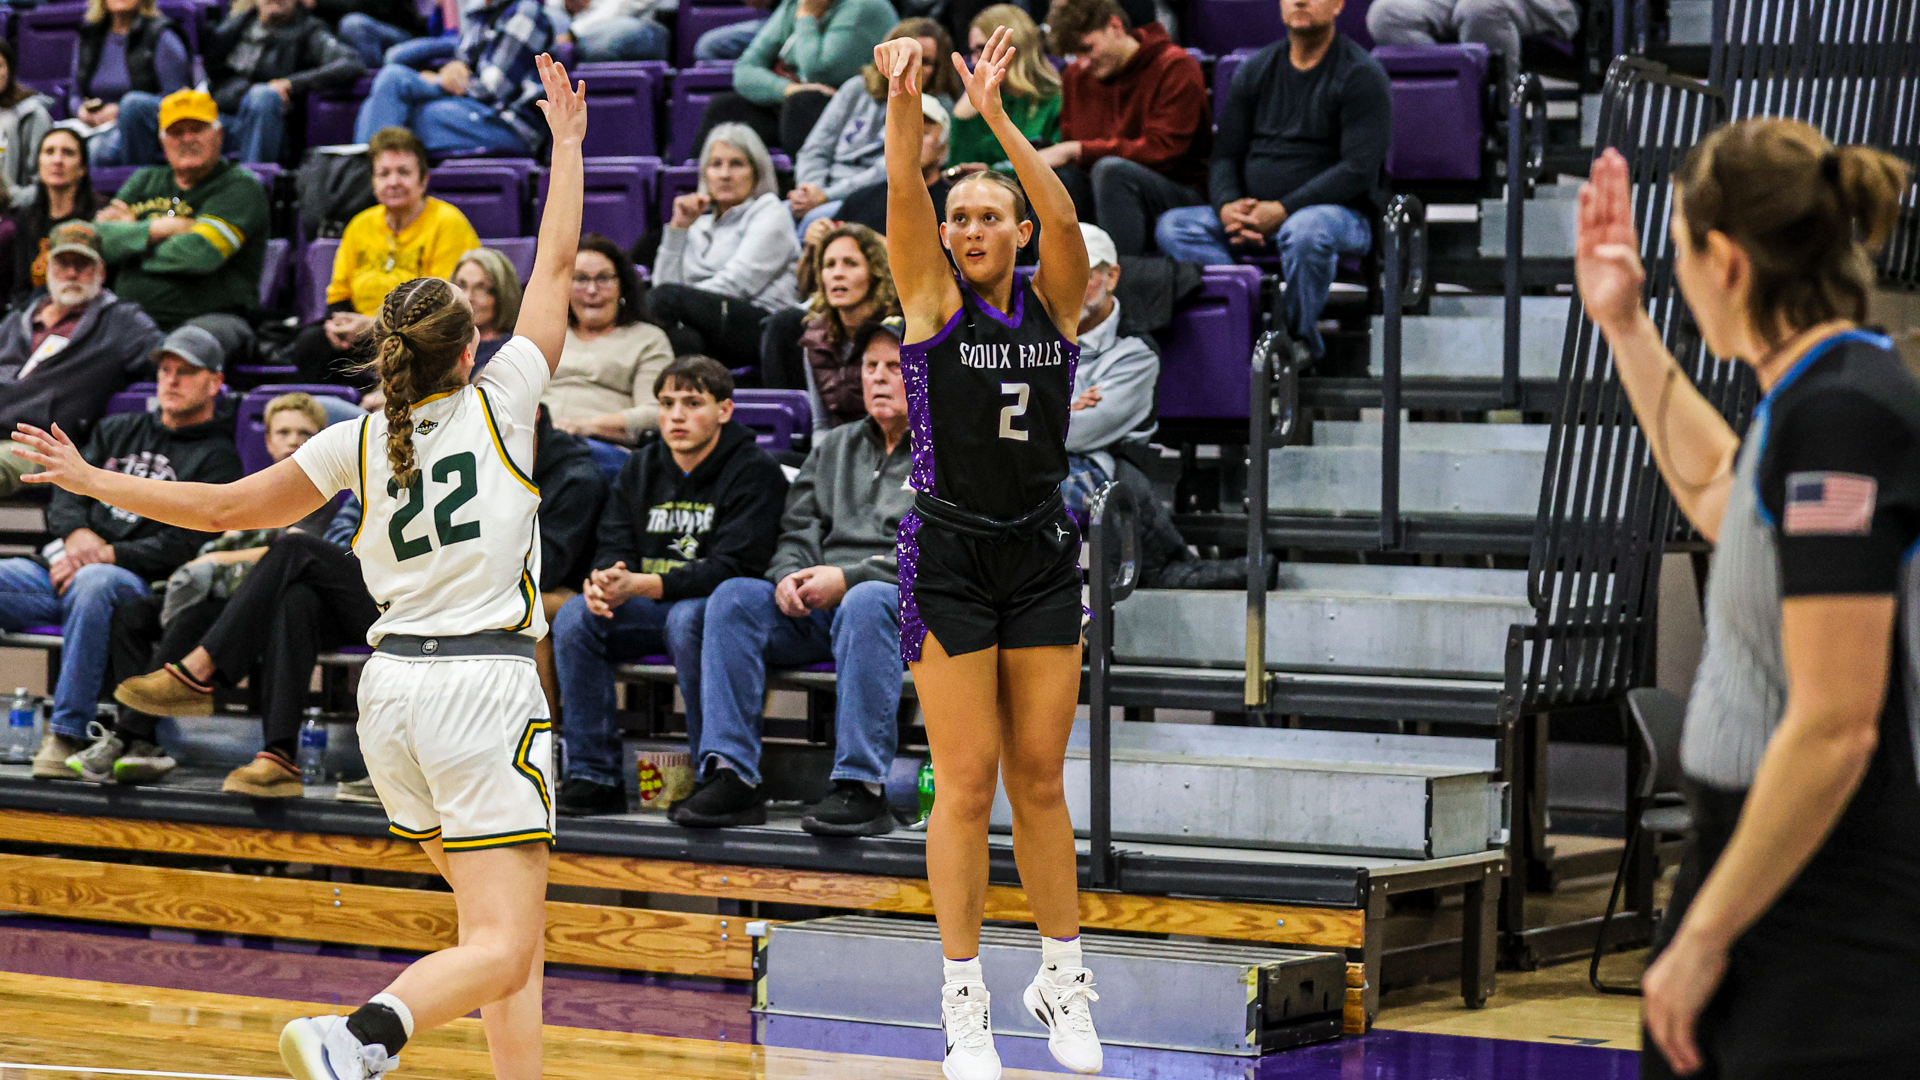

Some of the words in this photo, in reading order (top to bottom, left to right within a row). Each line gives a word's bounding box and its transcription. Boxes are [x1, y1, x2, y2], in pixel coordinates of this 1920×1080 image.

[960, 342, 1012, 369] SIOUX
[1019, 340, 1062, 369] FALLS
[998, 382, 1031, 441] 2
[387, 450, 481, 562] 22
